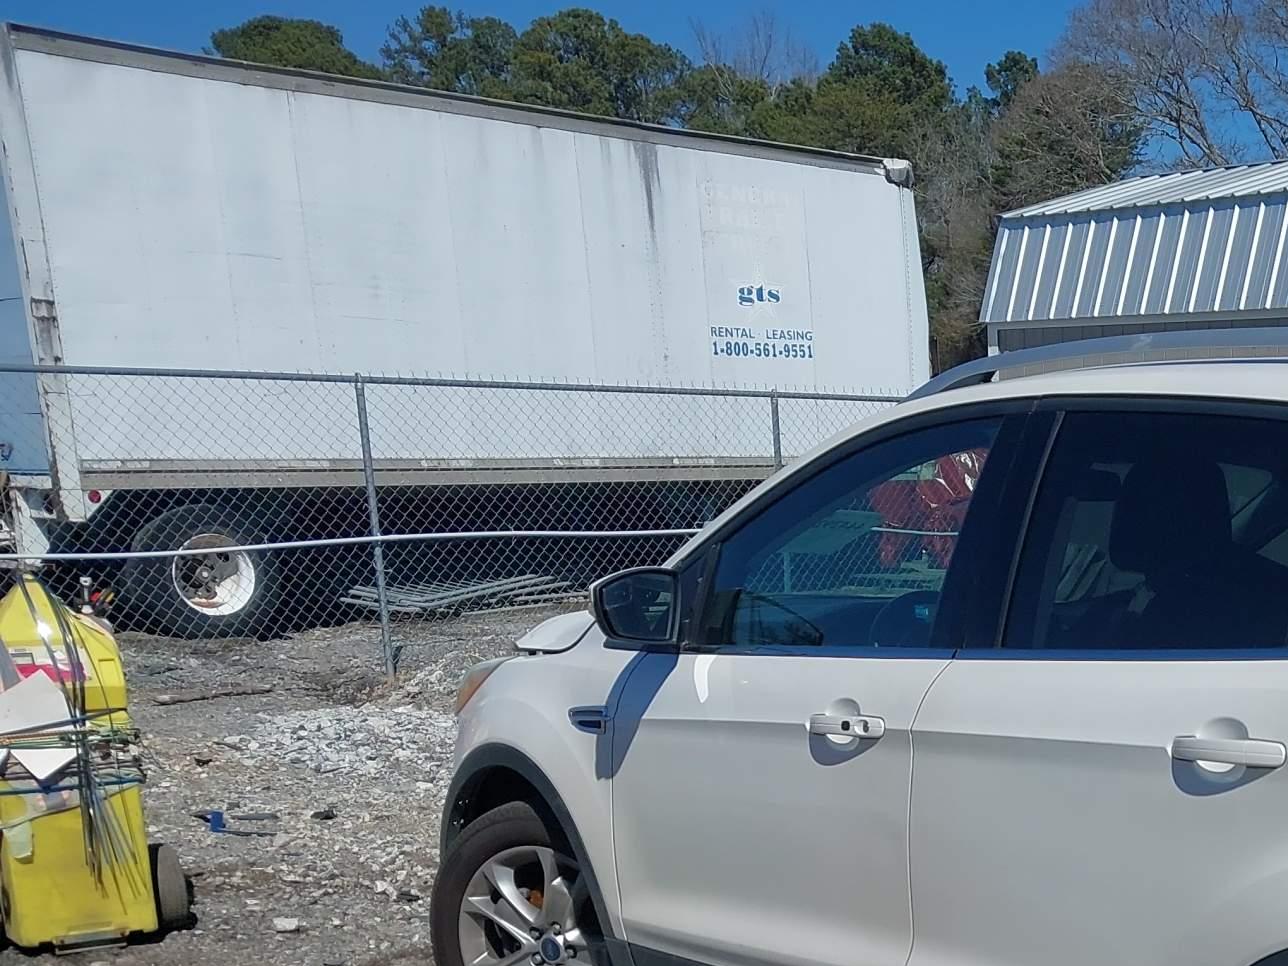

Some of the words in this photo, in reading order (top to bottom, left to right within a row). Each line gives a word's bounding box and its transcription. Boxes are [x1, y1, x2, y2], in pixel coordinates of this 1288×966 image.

[738, 285, 780, 306] gts
[710, 326, 755, 339] RENTAL
[765, 329, 813, 341] LEASING
[712, 341, 813, 358] 1-800-561-9551
